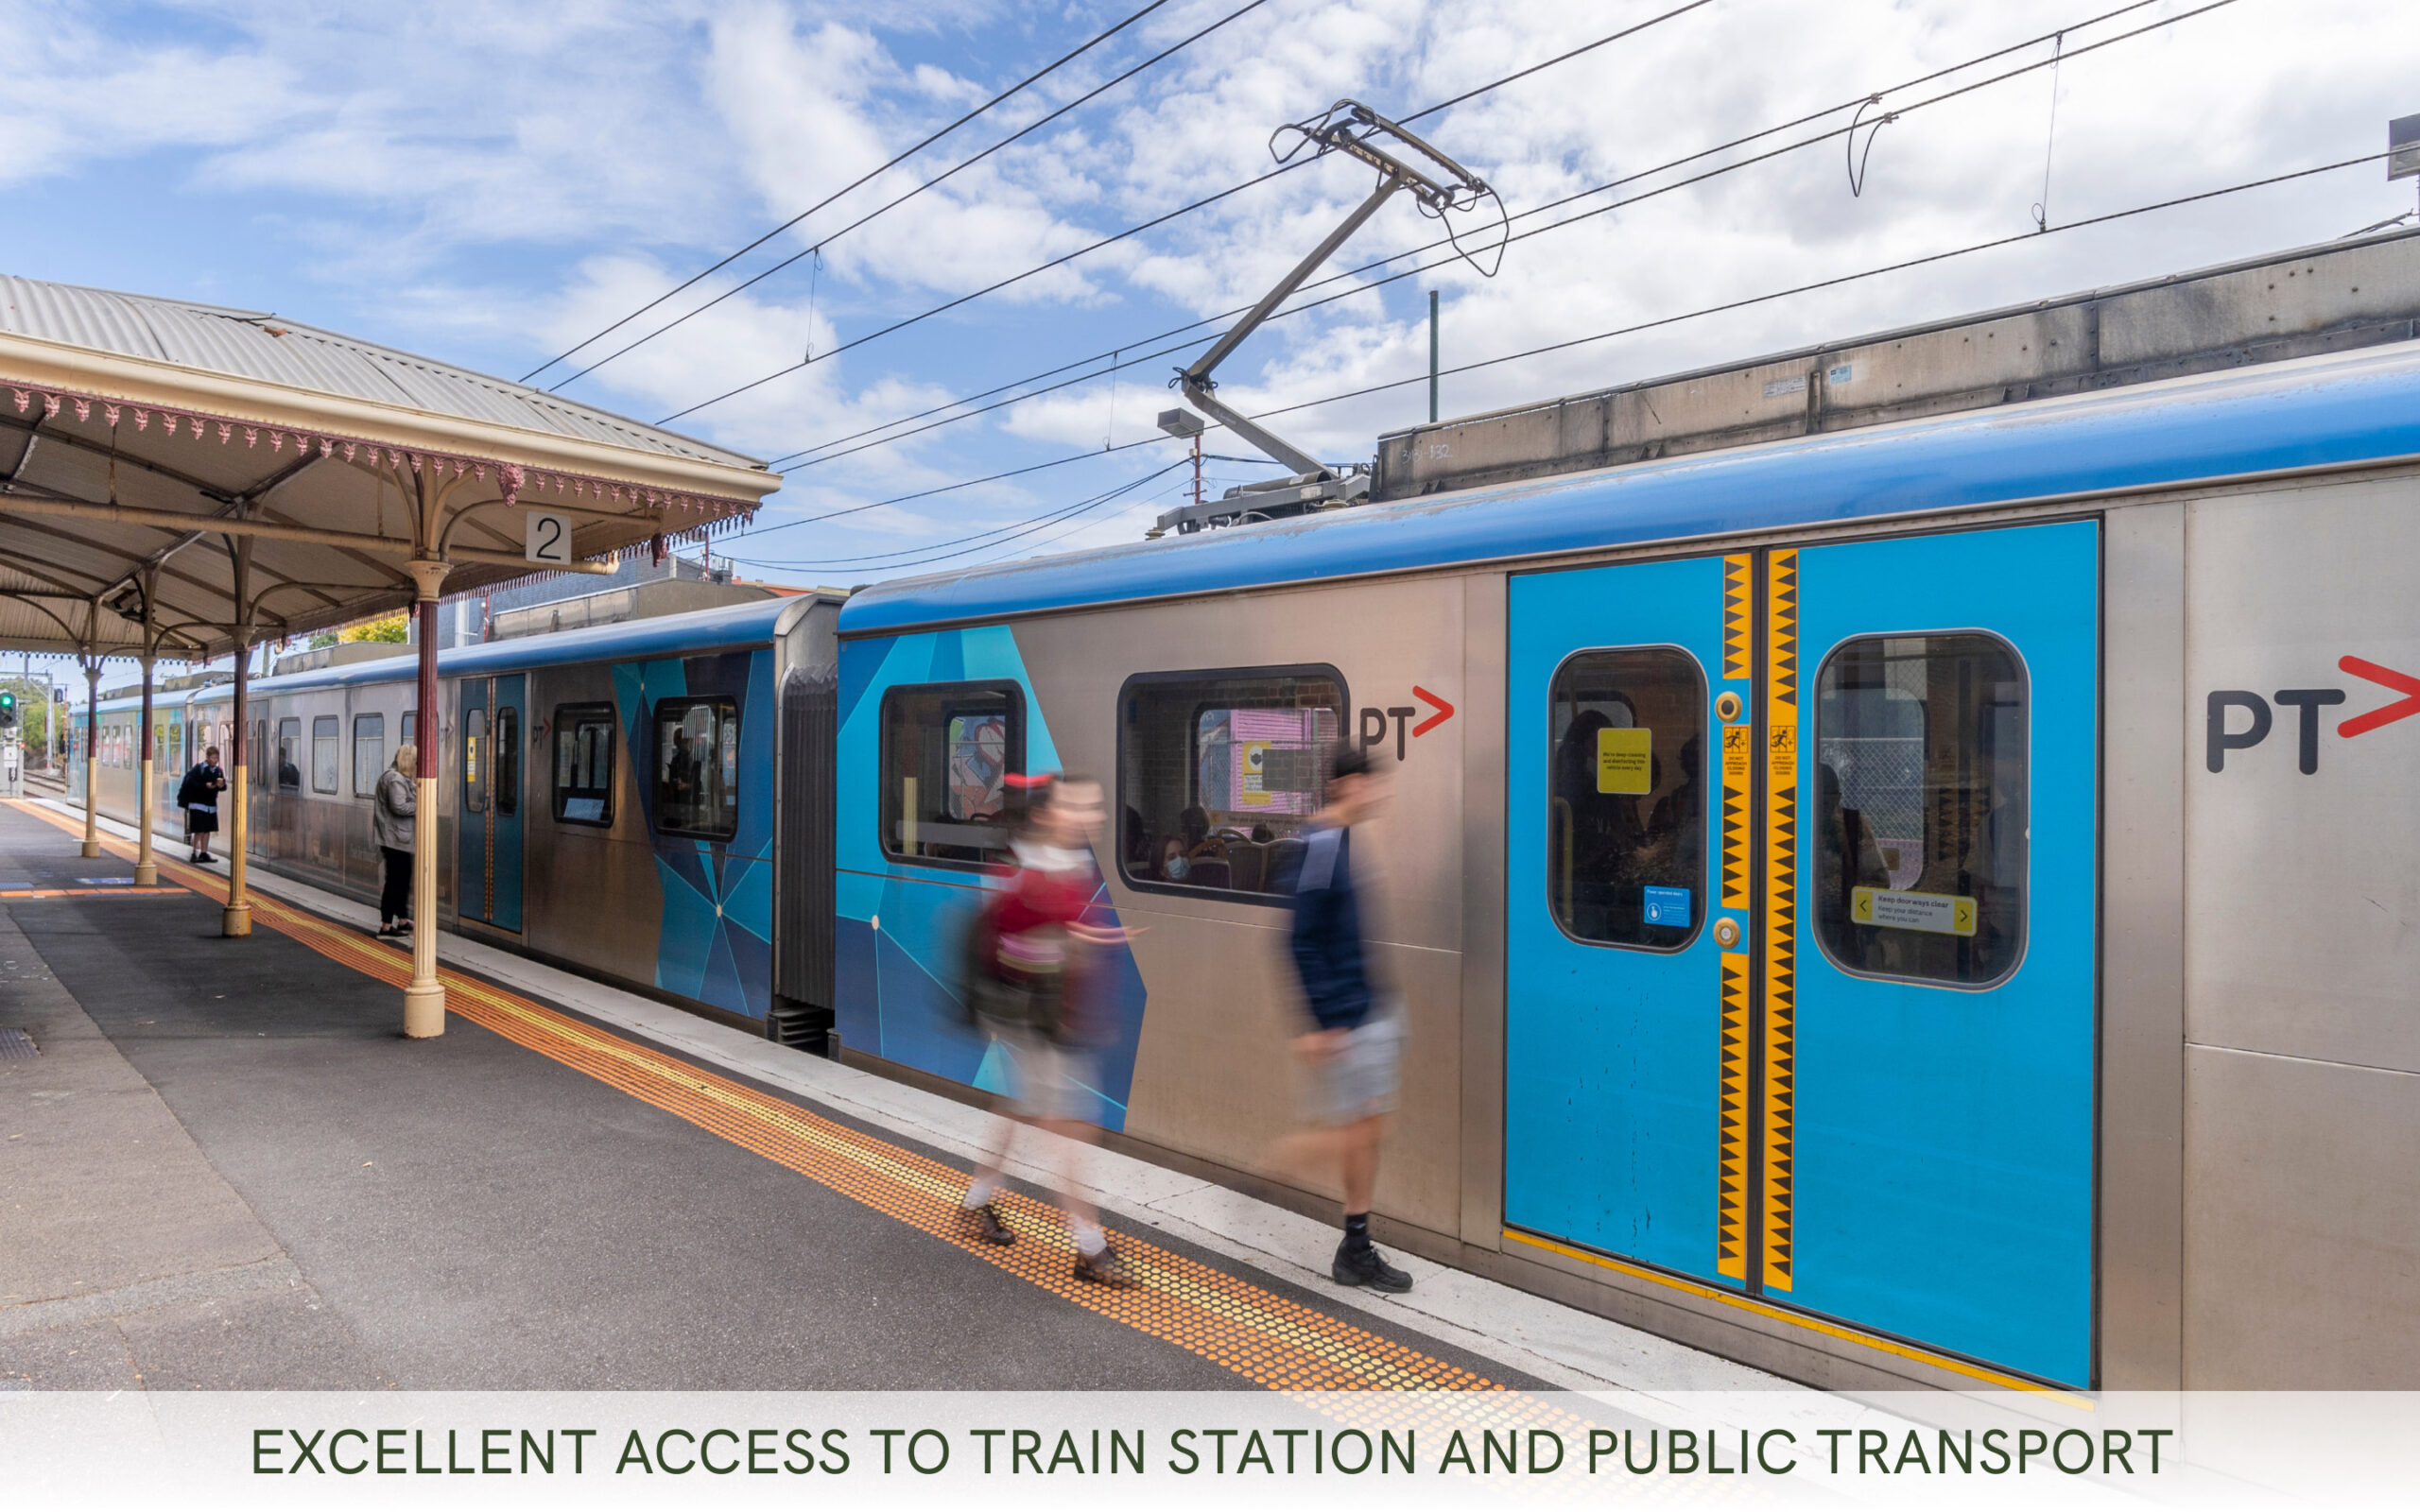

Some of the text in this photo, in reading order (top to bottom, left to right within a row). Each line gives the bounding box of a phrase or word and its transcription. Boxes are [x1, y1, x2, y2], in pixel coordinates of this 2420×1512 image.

[537, 517, 562, 559] 2
[1878, 895, 1949, 908] Keep doorways clear
